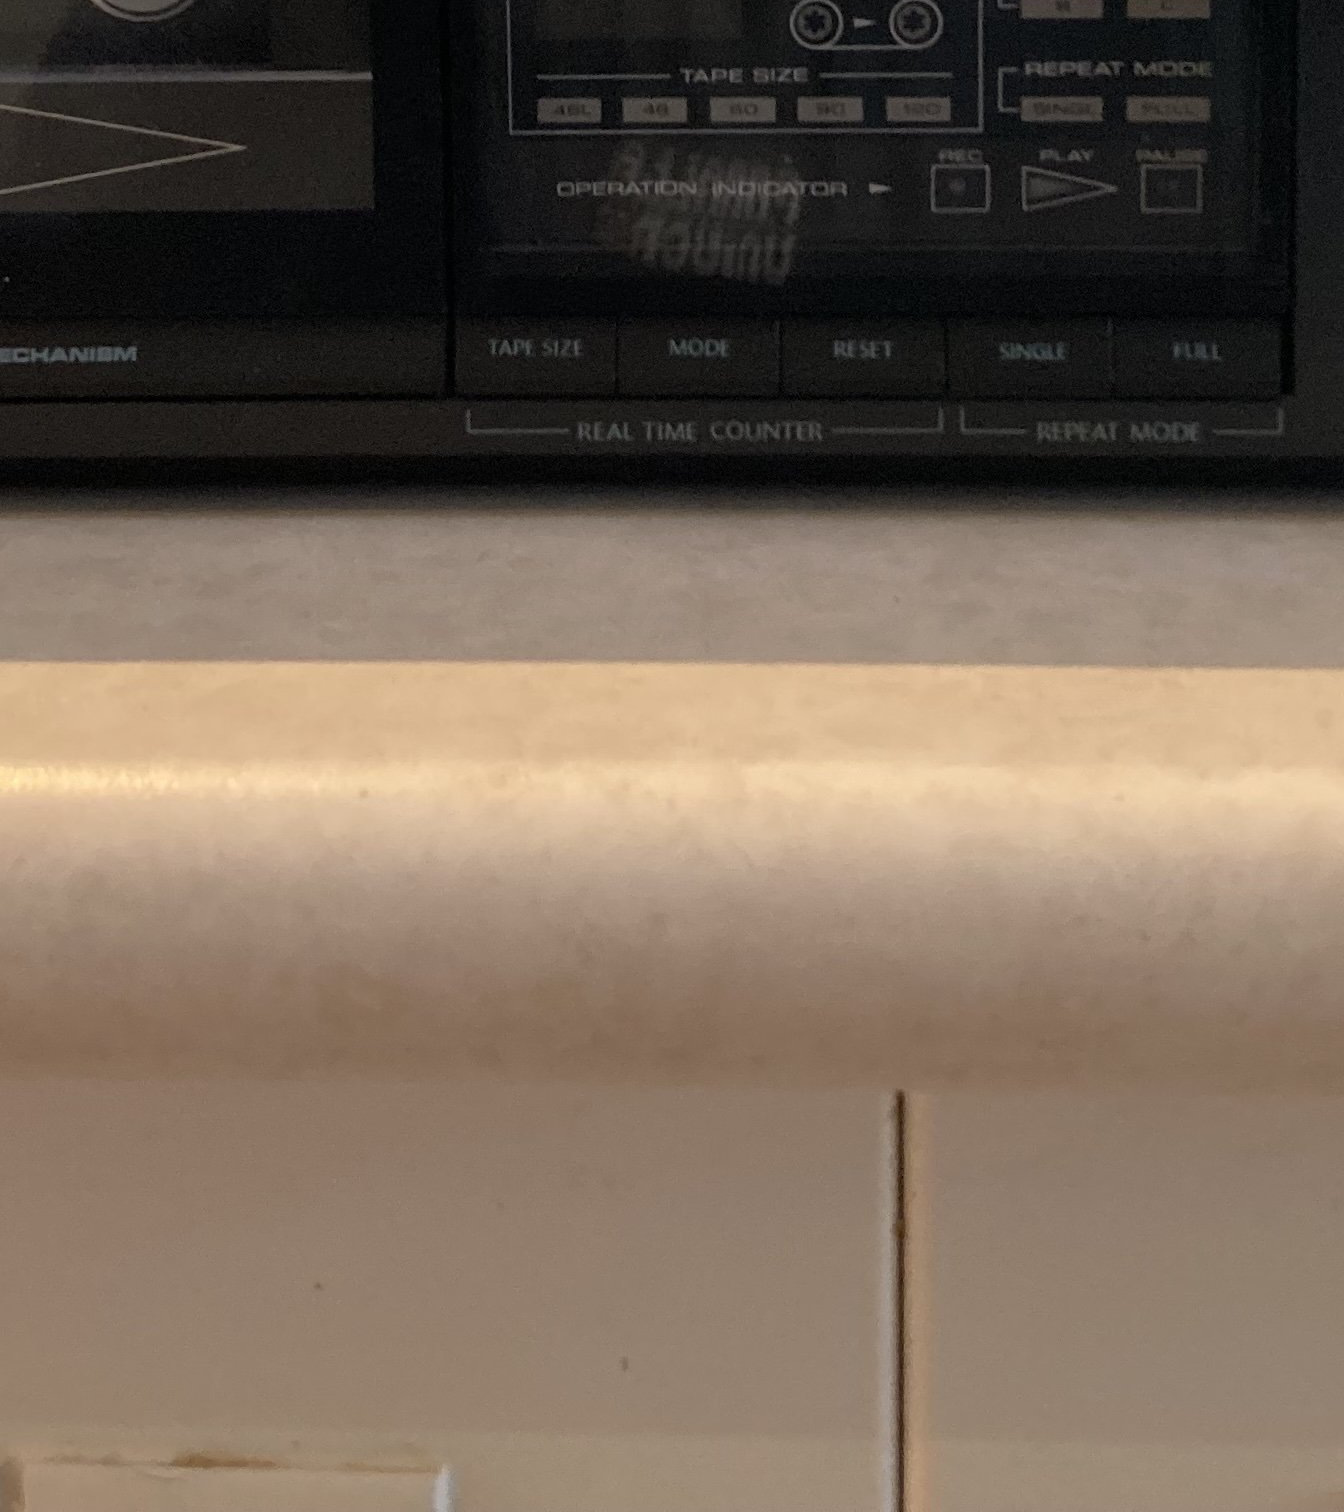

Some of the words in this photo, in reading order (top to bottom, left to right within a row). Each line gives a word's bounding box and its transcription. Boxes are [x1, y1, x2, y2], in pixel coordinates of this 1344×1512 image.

[681, 67, 744, 84] TAPE
[753, 67, 809, 83] SIZE
[1024, 61, 1125, 77] REPEAT
[1133, 61, 1213, 77] MODE
[1039, 148, 1094, 162] PLAY
[556, 181, 697, 197] OPERATION
[711, 181, 849, 197] INDICATOR
[487, 337, 538, 360] TAPE
[542, 337, 585, 360] SIZE
[667, 337, 732, 359] MODE
[832, 338, 894, 360] RESET
[997, 341, 1069, 364] SINGLE
[1171, 341, 1222, 364] FULL
[575, 419, 636, 444] REAL
[642, 419, 698, 443] TIME
[709, 418, 824, 443] COUNTER
[1035, 418, 1119, 443] REPEAT
[1129, 419, 1203, 443] MODE
